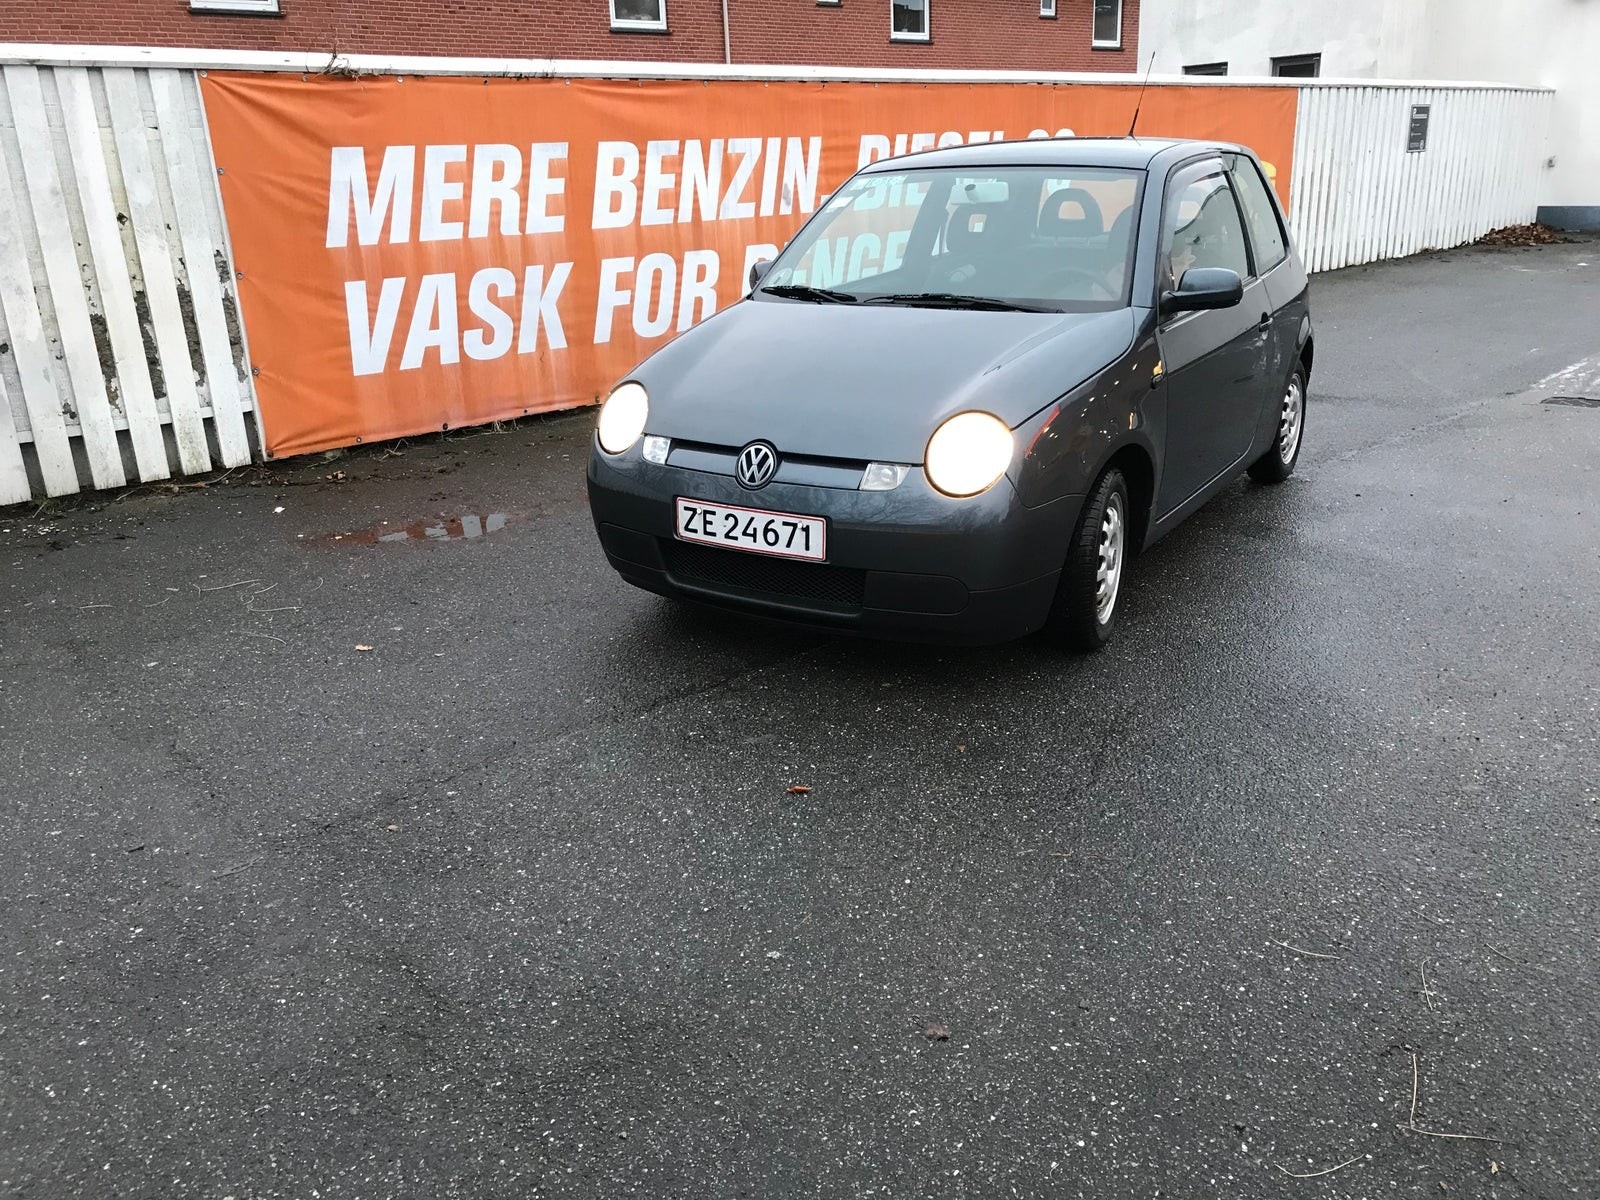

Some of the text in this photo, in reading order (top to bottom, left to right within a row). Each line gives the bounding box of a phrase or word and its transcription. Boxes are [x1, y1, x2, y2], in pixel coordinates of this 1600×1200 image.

[326, 142, 568, 248] MERE
[345, 262, 574, 377] VASK
[593, 249, 720, 344] FOR
